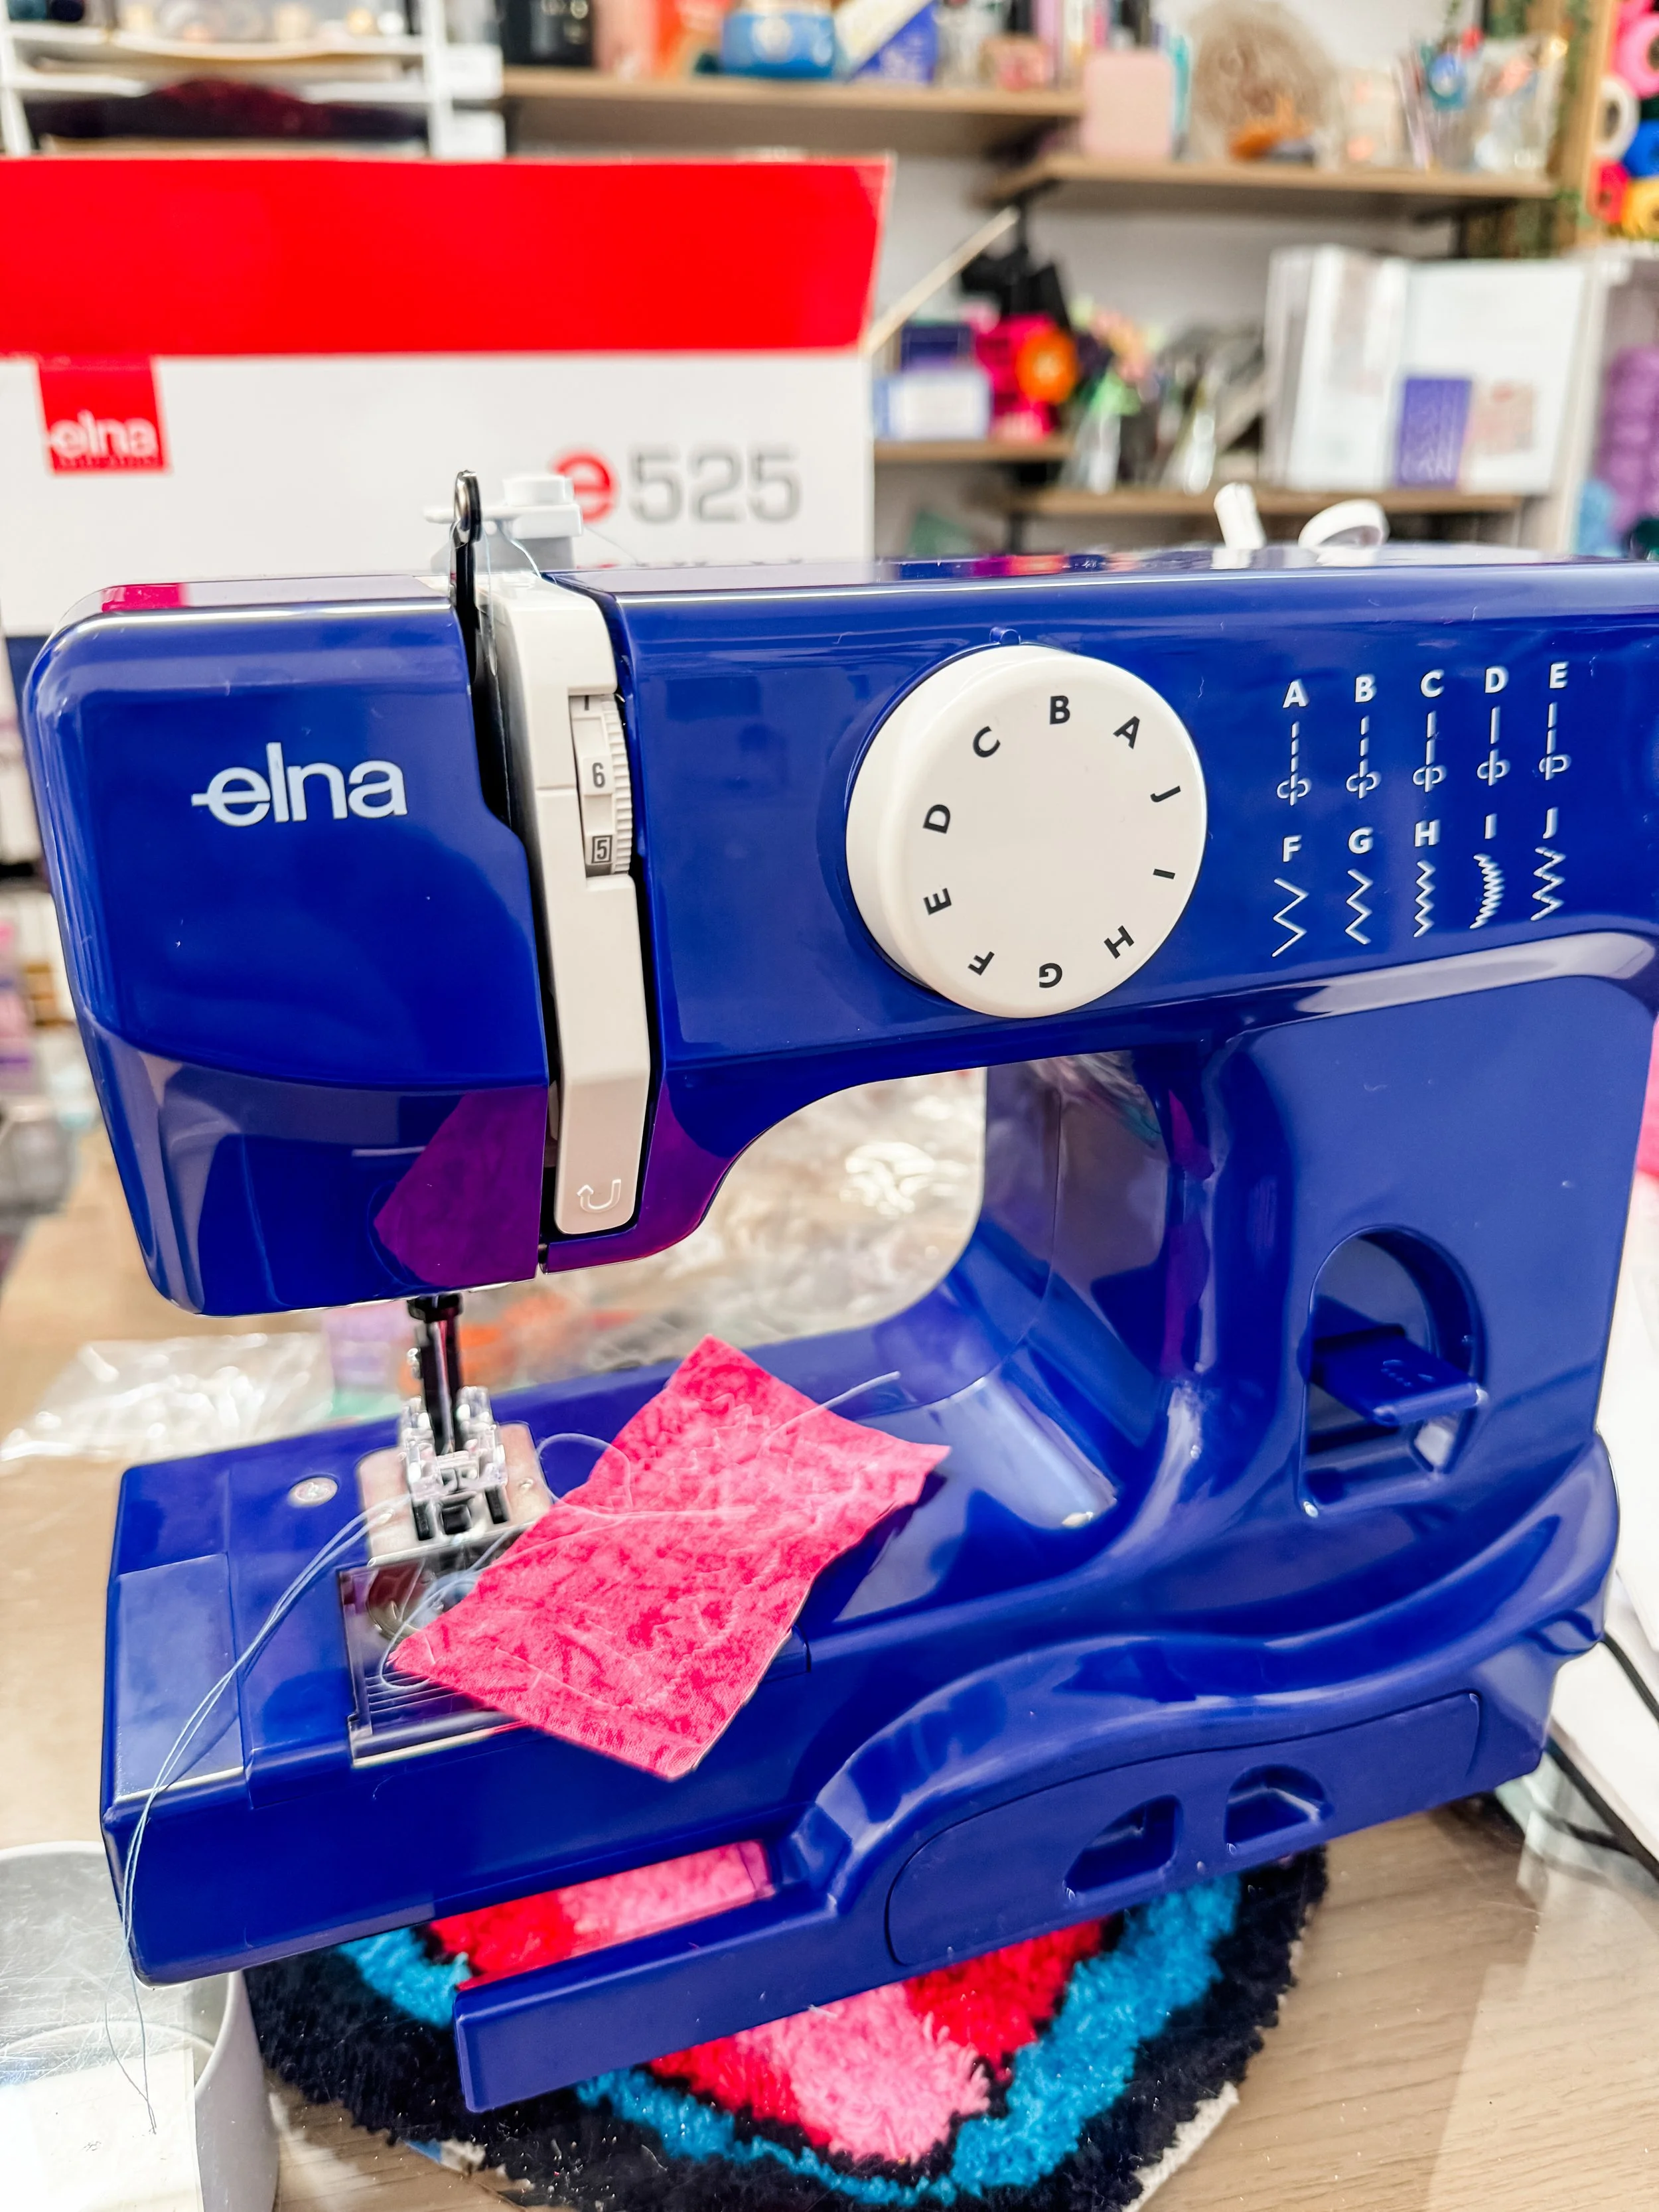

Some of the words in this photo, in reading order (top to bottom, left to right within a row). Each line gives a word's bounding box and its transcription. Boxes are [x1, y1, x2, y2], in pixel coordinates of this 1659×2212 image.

[46, 409, 159, 458] elna
[551, 443, 802, 524] e525
[1283, 678, 1309, 707] A
[1355, 674, 1376, 703] B
[1420, 670, 1444, 698] C
[1484, 666, 1508, 693] D
[1549, 661, 1569, 689] E
[1050, 695, 1070, 725] B
[973, 726, 1001, 758] C
[1113, 716, 1141, 749] A
[191, 742, 407, 827] elna
[592, 762, 606, 788] 6
[1151, 786, 1181, 803] J
[922, 804, 950, 834] D
[1283, 835, 1301, 862] F
[1348, 826, 1373, 854] G
[1415, 819, 1441, 847] H
[1484, 813, 1497, 839] I
[1542, 806, 1558, 839] J
[597, 840, 608, 860] 5
[1153, 869, 1175, 879] I
[923, 888, 952, 915] E
[1104, 925, 1134, 959] H
[968, 951, 995, 976] F
[1039, 963, 1062, 988] G
